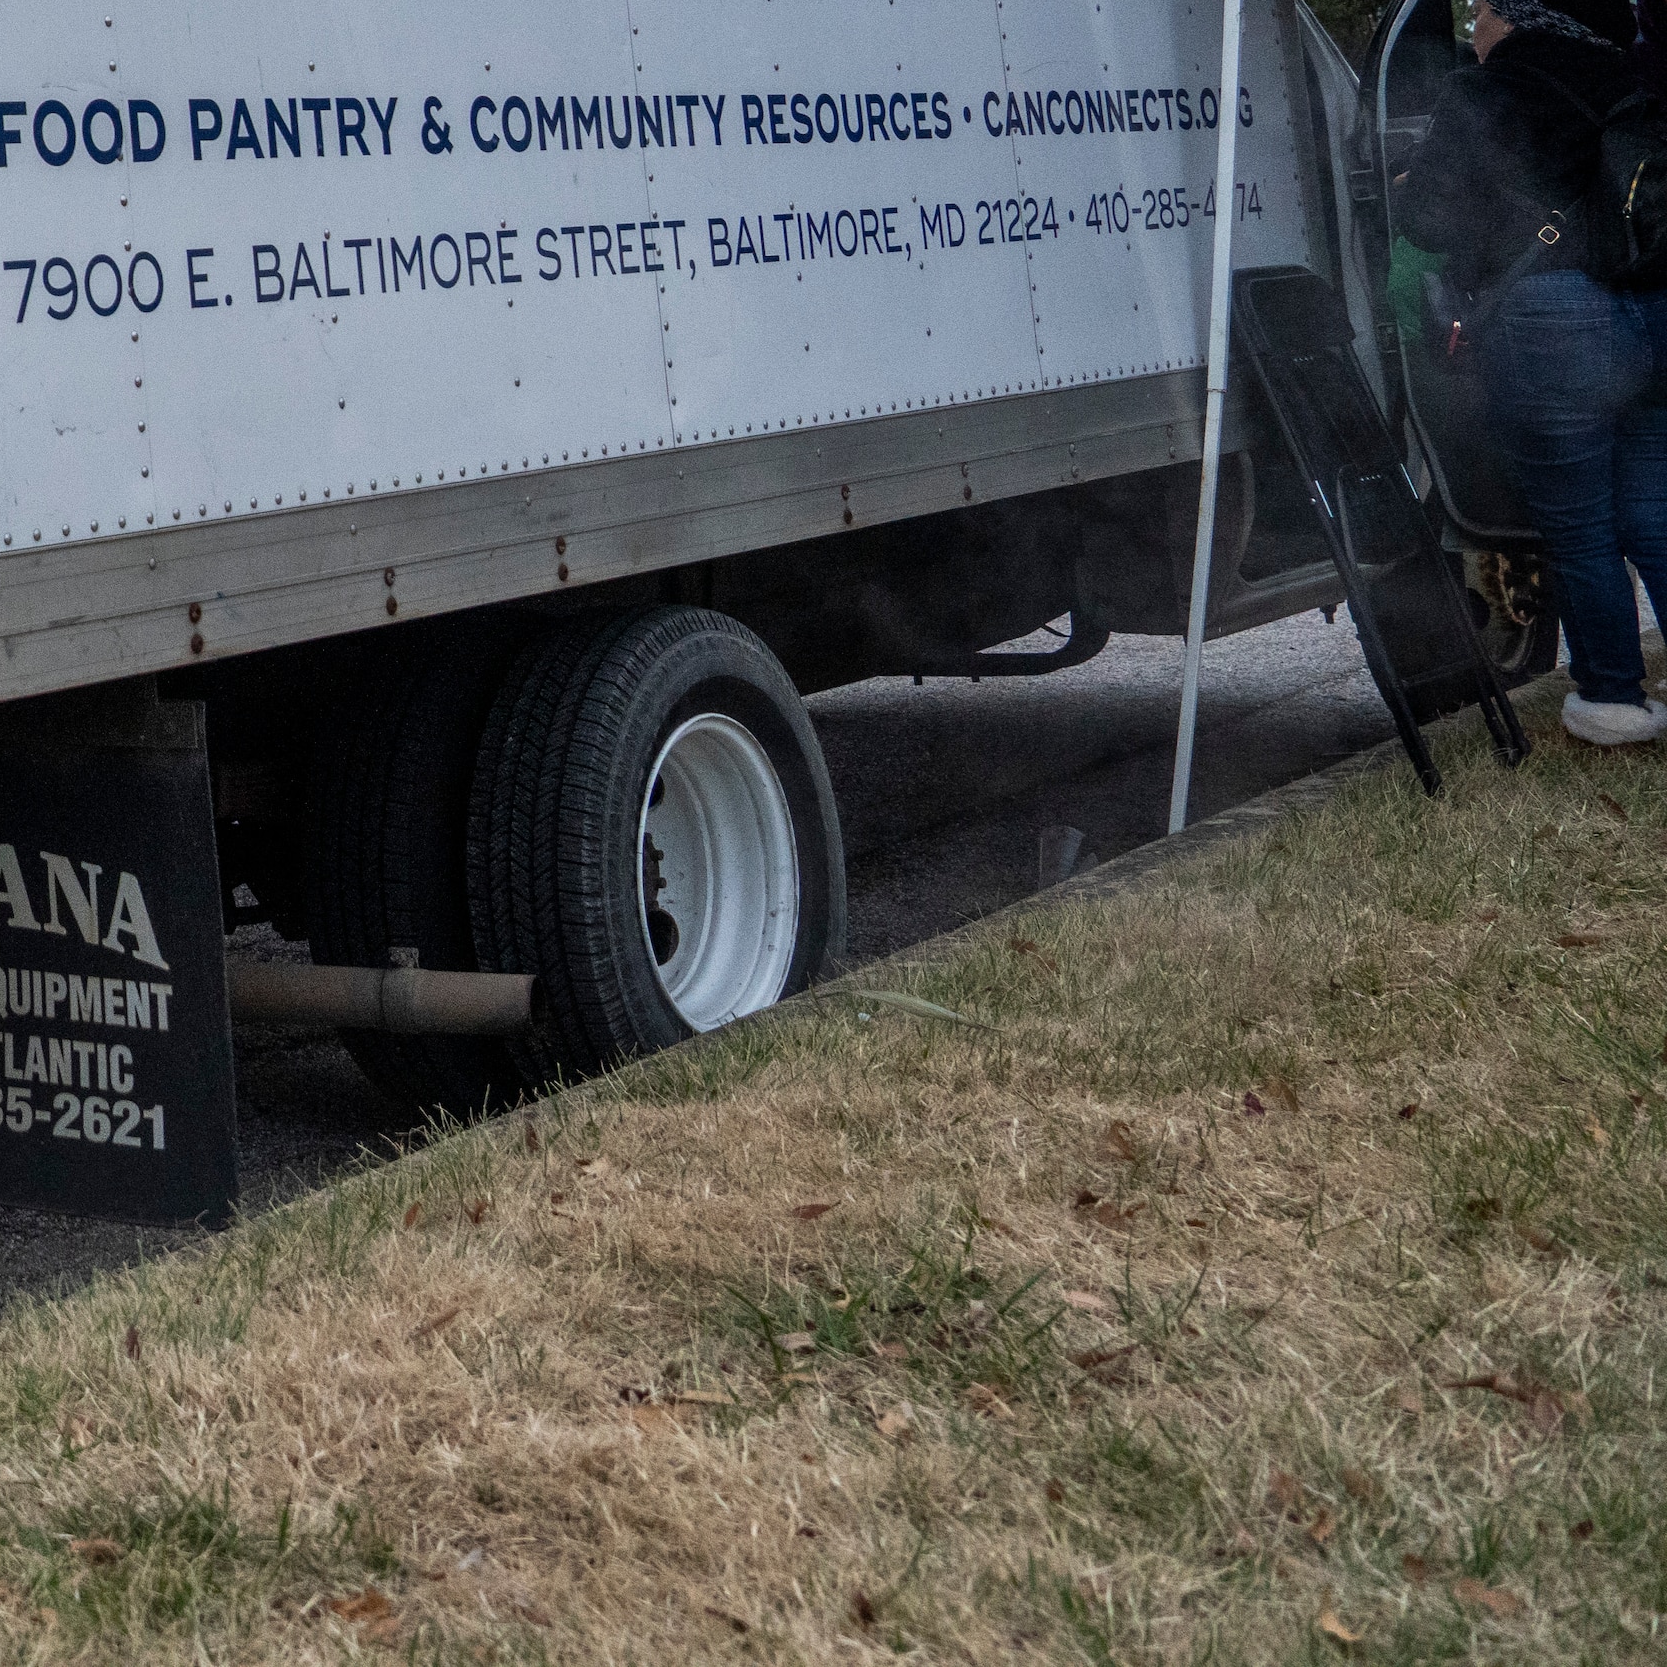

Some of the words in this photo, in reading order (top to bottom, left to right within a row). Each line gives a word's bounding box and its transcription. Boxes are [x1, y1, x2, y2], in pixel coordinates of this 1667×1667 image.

[189, 97, 397, 160] PANTRY
[421, 96, 453, 154] &
[470, 94, 725, 153] COMMUNITY
[744, 92, 952, 145] RESOURCES
[984, 87, 1254, 137] CANCONNECTS.OG
[3, 251, 163, 323] 7900
[187, 248, 233, 309] E.
[253, 228, 522, 304] BALTIMORE
[537, 219, 696, 280] STREET,
[711, 206, 911, 266] BALTIMORE,
[921, 203, 965, 251] MD
[975, 196, 1060, 245] 21224
[1085, 182, 1263, 235] 410-285-474
